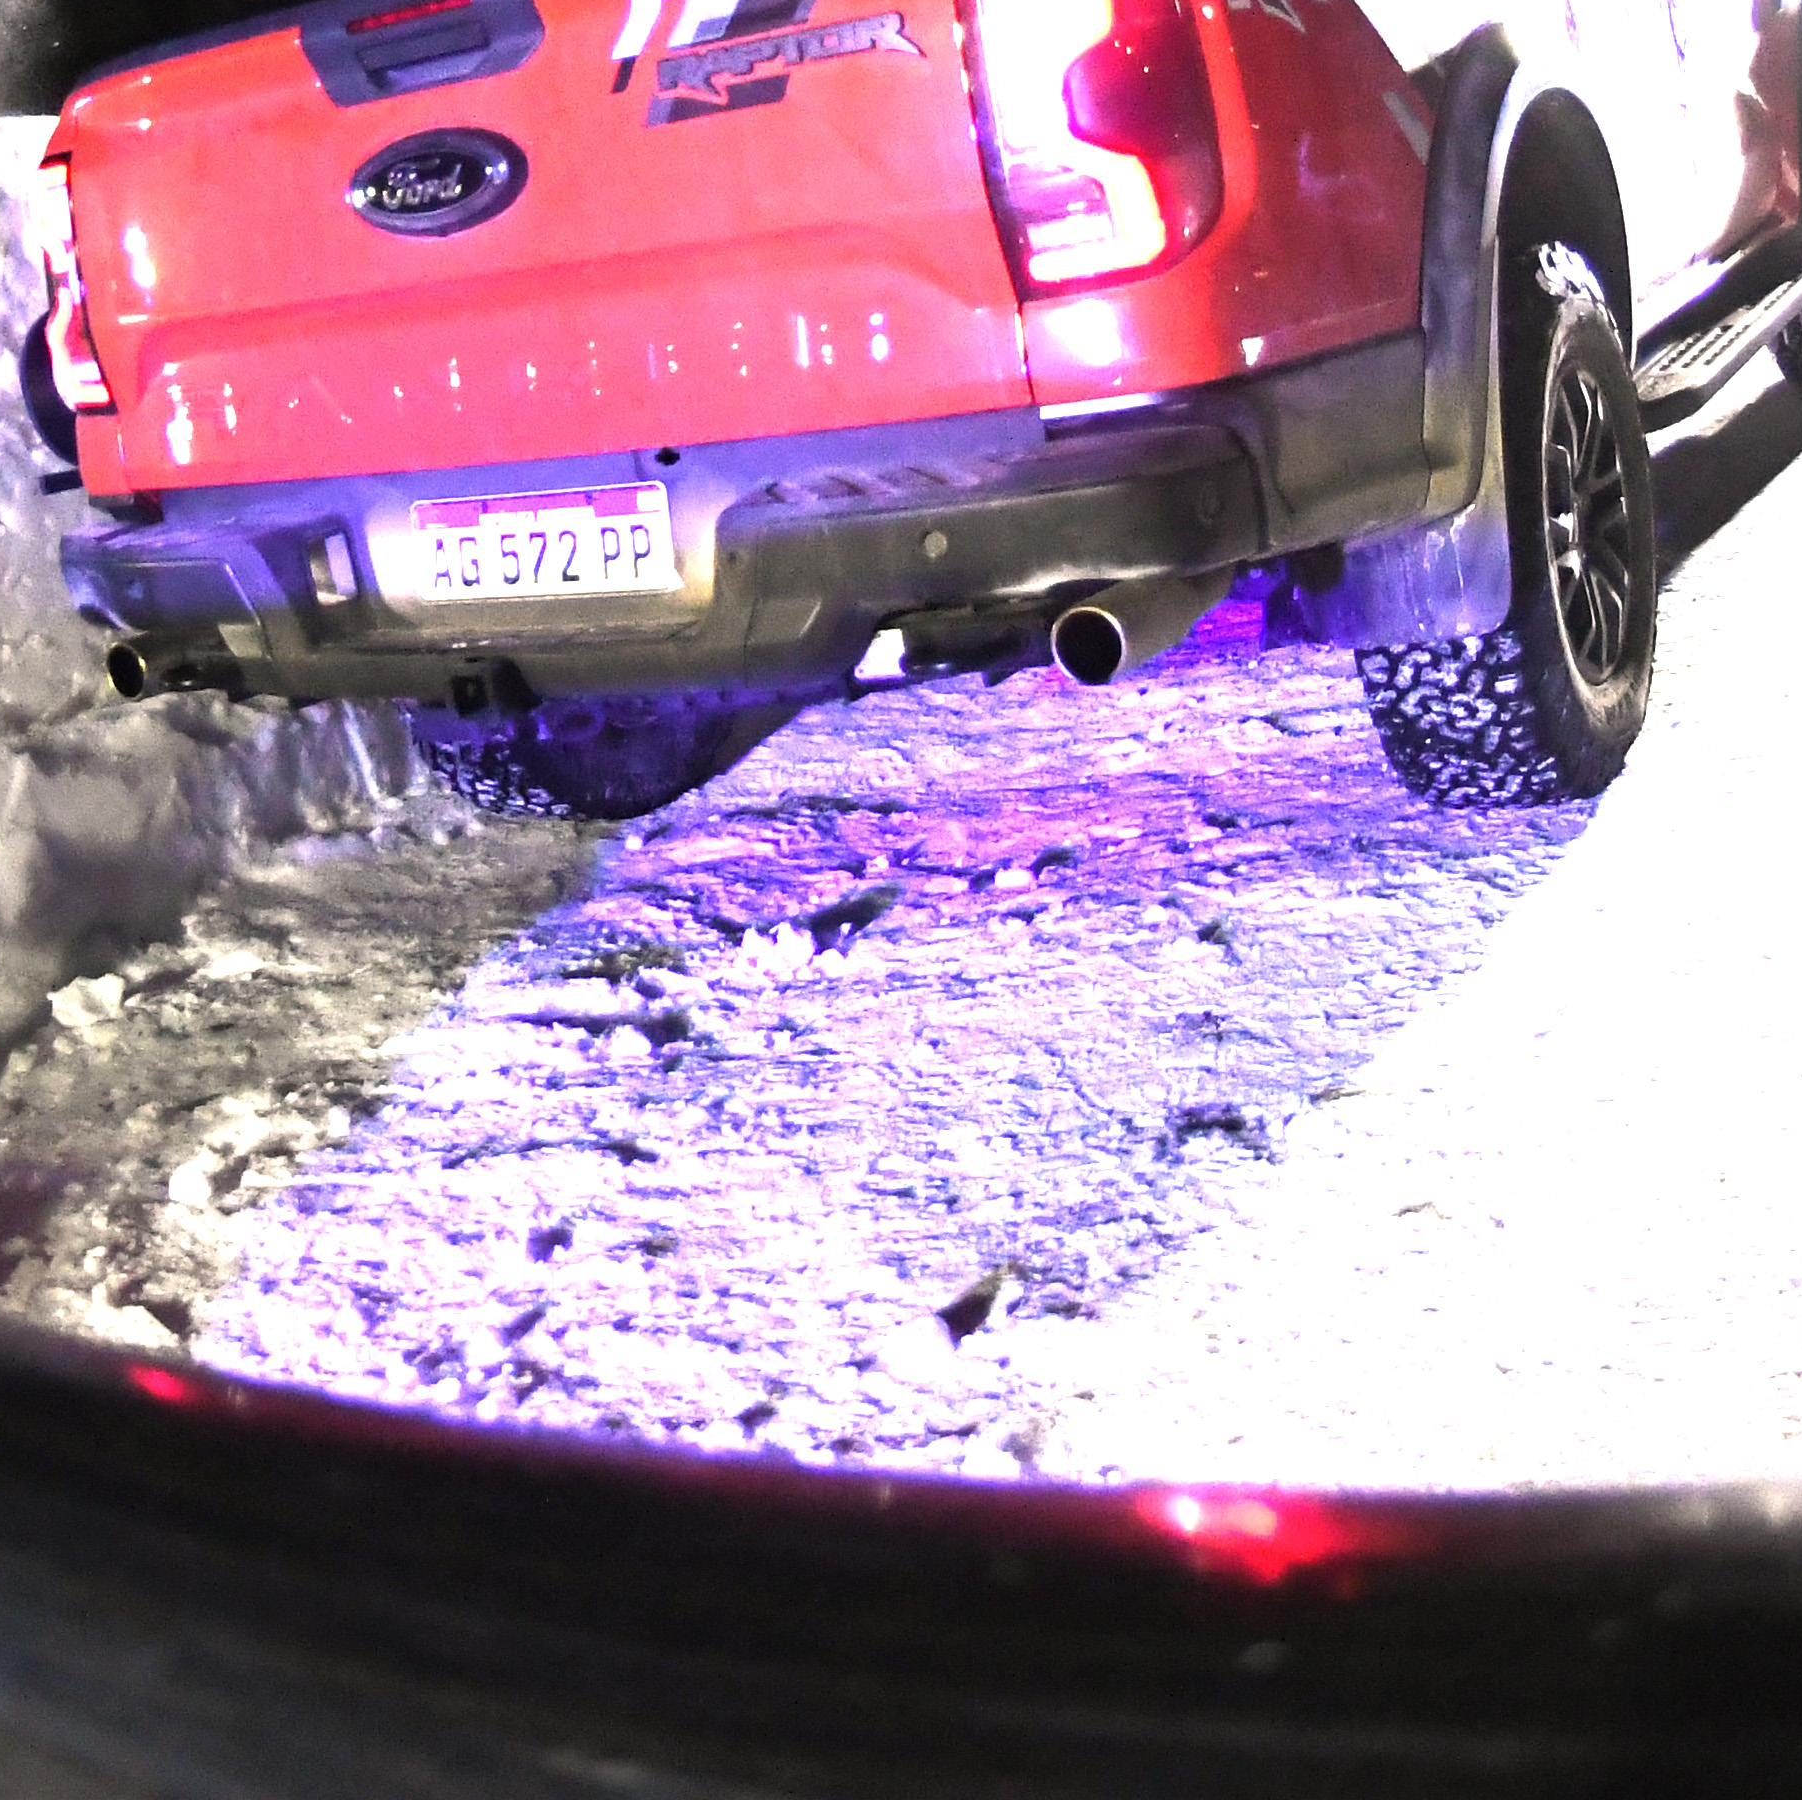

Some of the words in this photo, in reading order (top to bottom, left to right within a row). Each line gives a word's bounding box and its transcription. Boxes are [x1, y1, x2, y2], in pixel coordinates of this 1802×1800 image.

[656, 11, 927, 99] RAPTOR
[382, 157, 463, 210] Ford
[434, 536, 480, 588] AG
[500, 530, 580, 585] 572
[600, 524, 651, 579] PP
